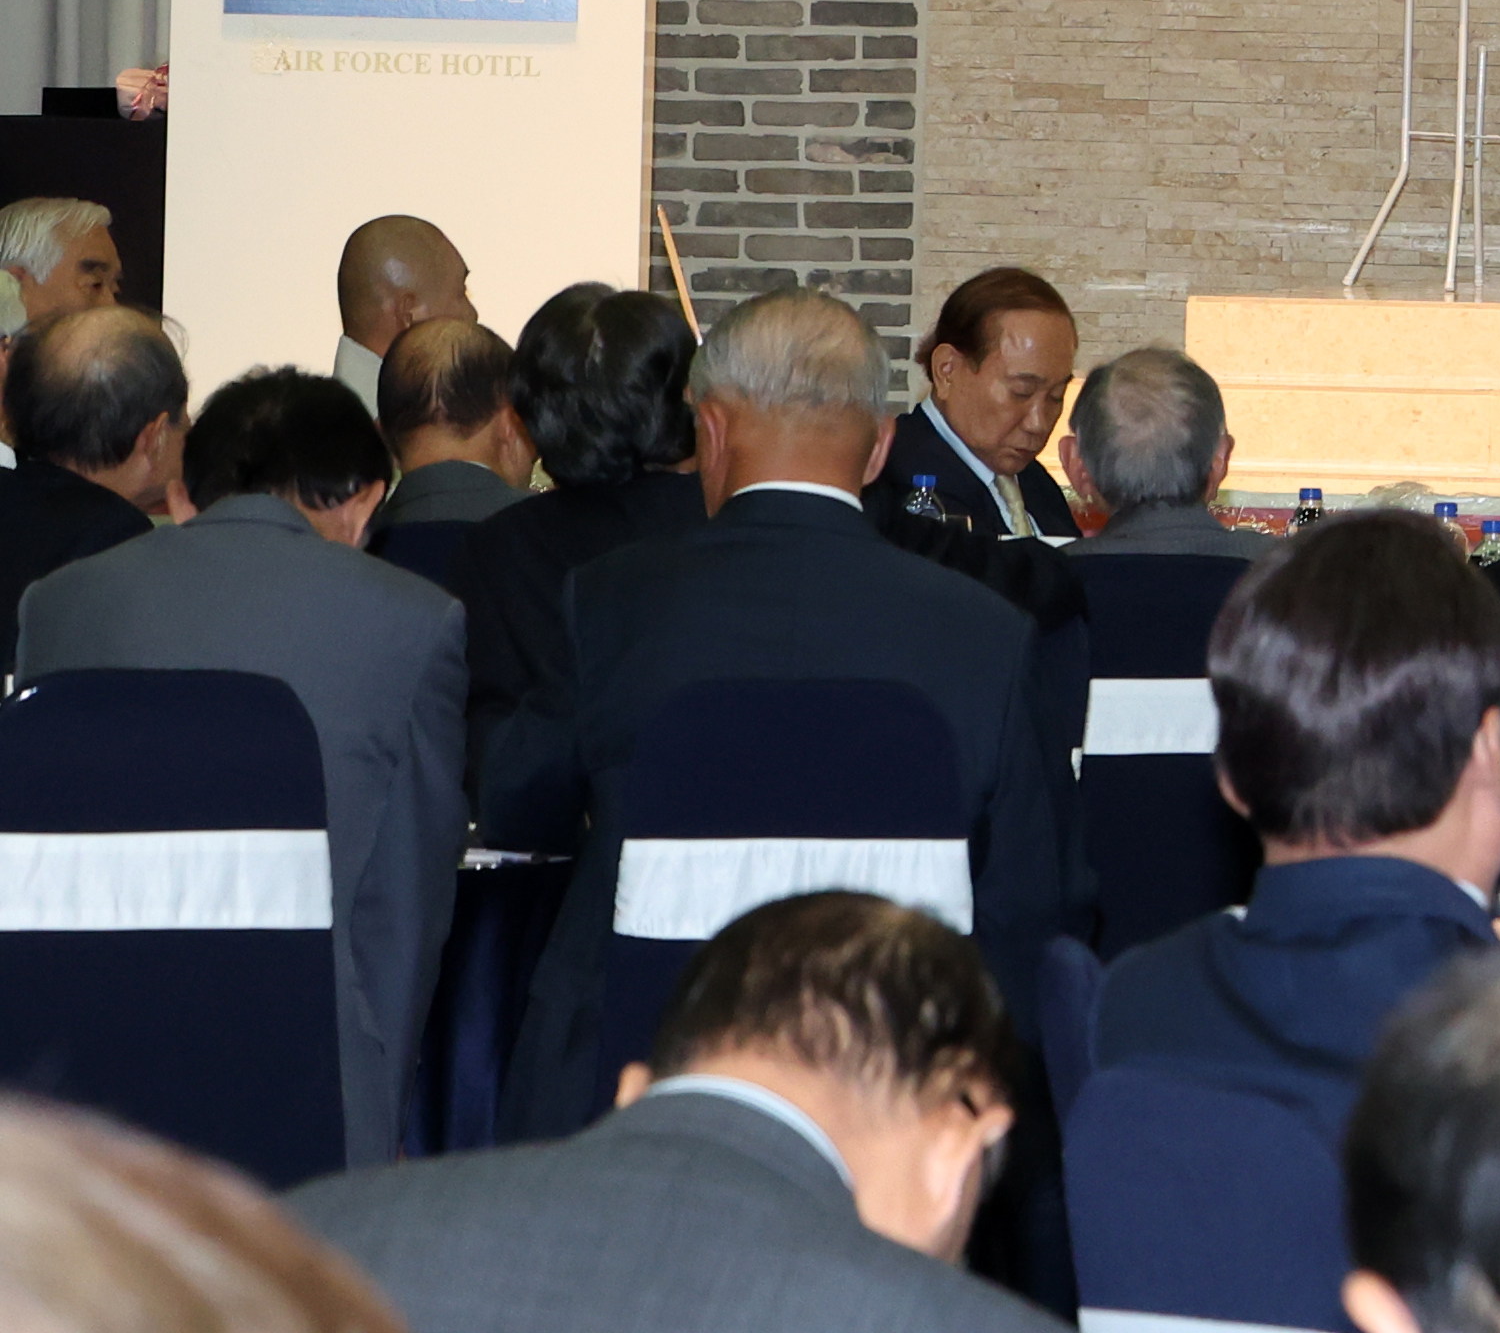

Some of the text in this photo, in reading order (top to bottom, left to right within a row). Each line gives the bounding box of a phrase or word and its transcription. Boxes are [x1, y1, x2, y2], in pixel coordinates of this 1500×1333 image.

[273, 48, 541, 78] AIR FORCE HOTEL
